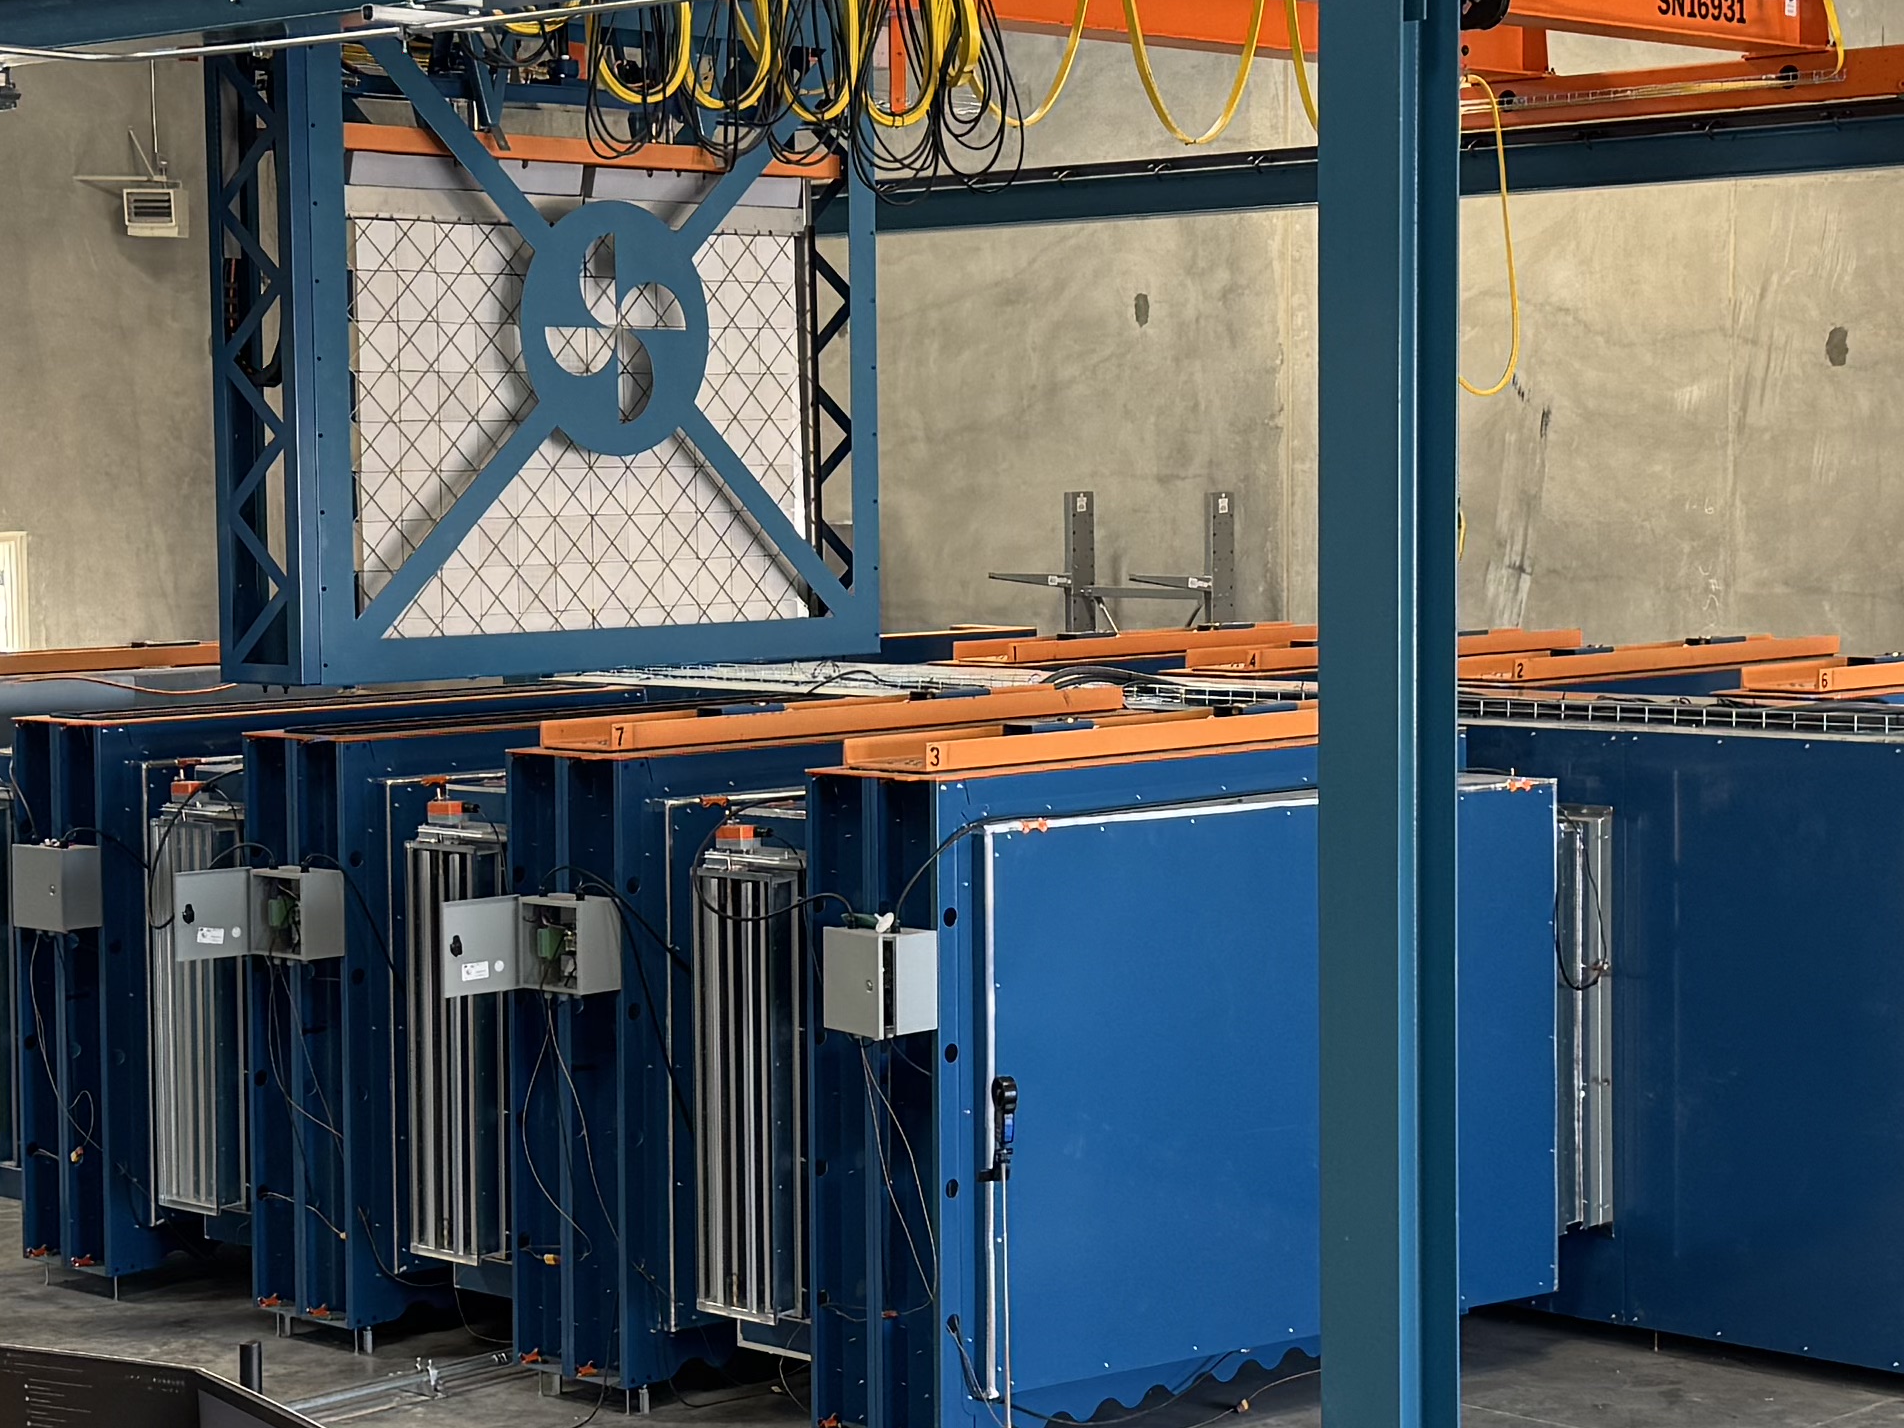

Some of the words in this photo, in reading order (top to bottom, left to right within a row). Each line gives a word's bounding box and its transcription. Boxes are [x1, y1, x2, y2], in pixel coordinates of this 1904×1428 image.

[1249, 653, 1256, 668] 4
[1517, 663, 1524, 679] 2
[1821, 672, 1828, 689] 6
[615, 726, 624, 746] 7
[930, 746, 940, 767] 3
